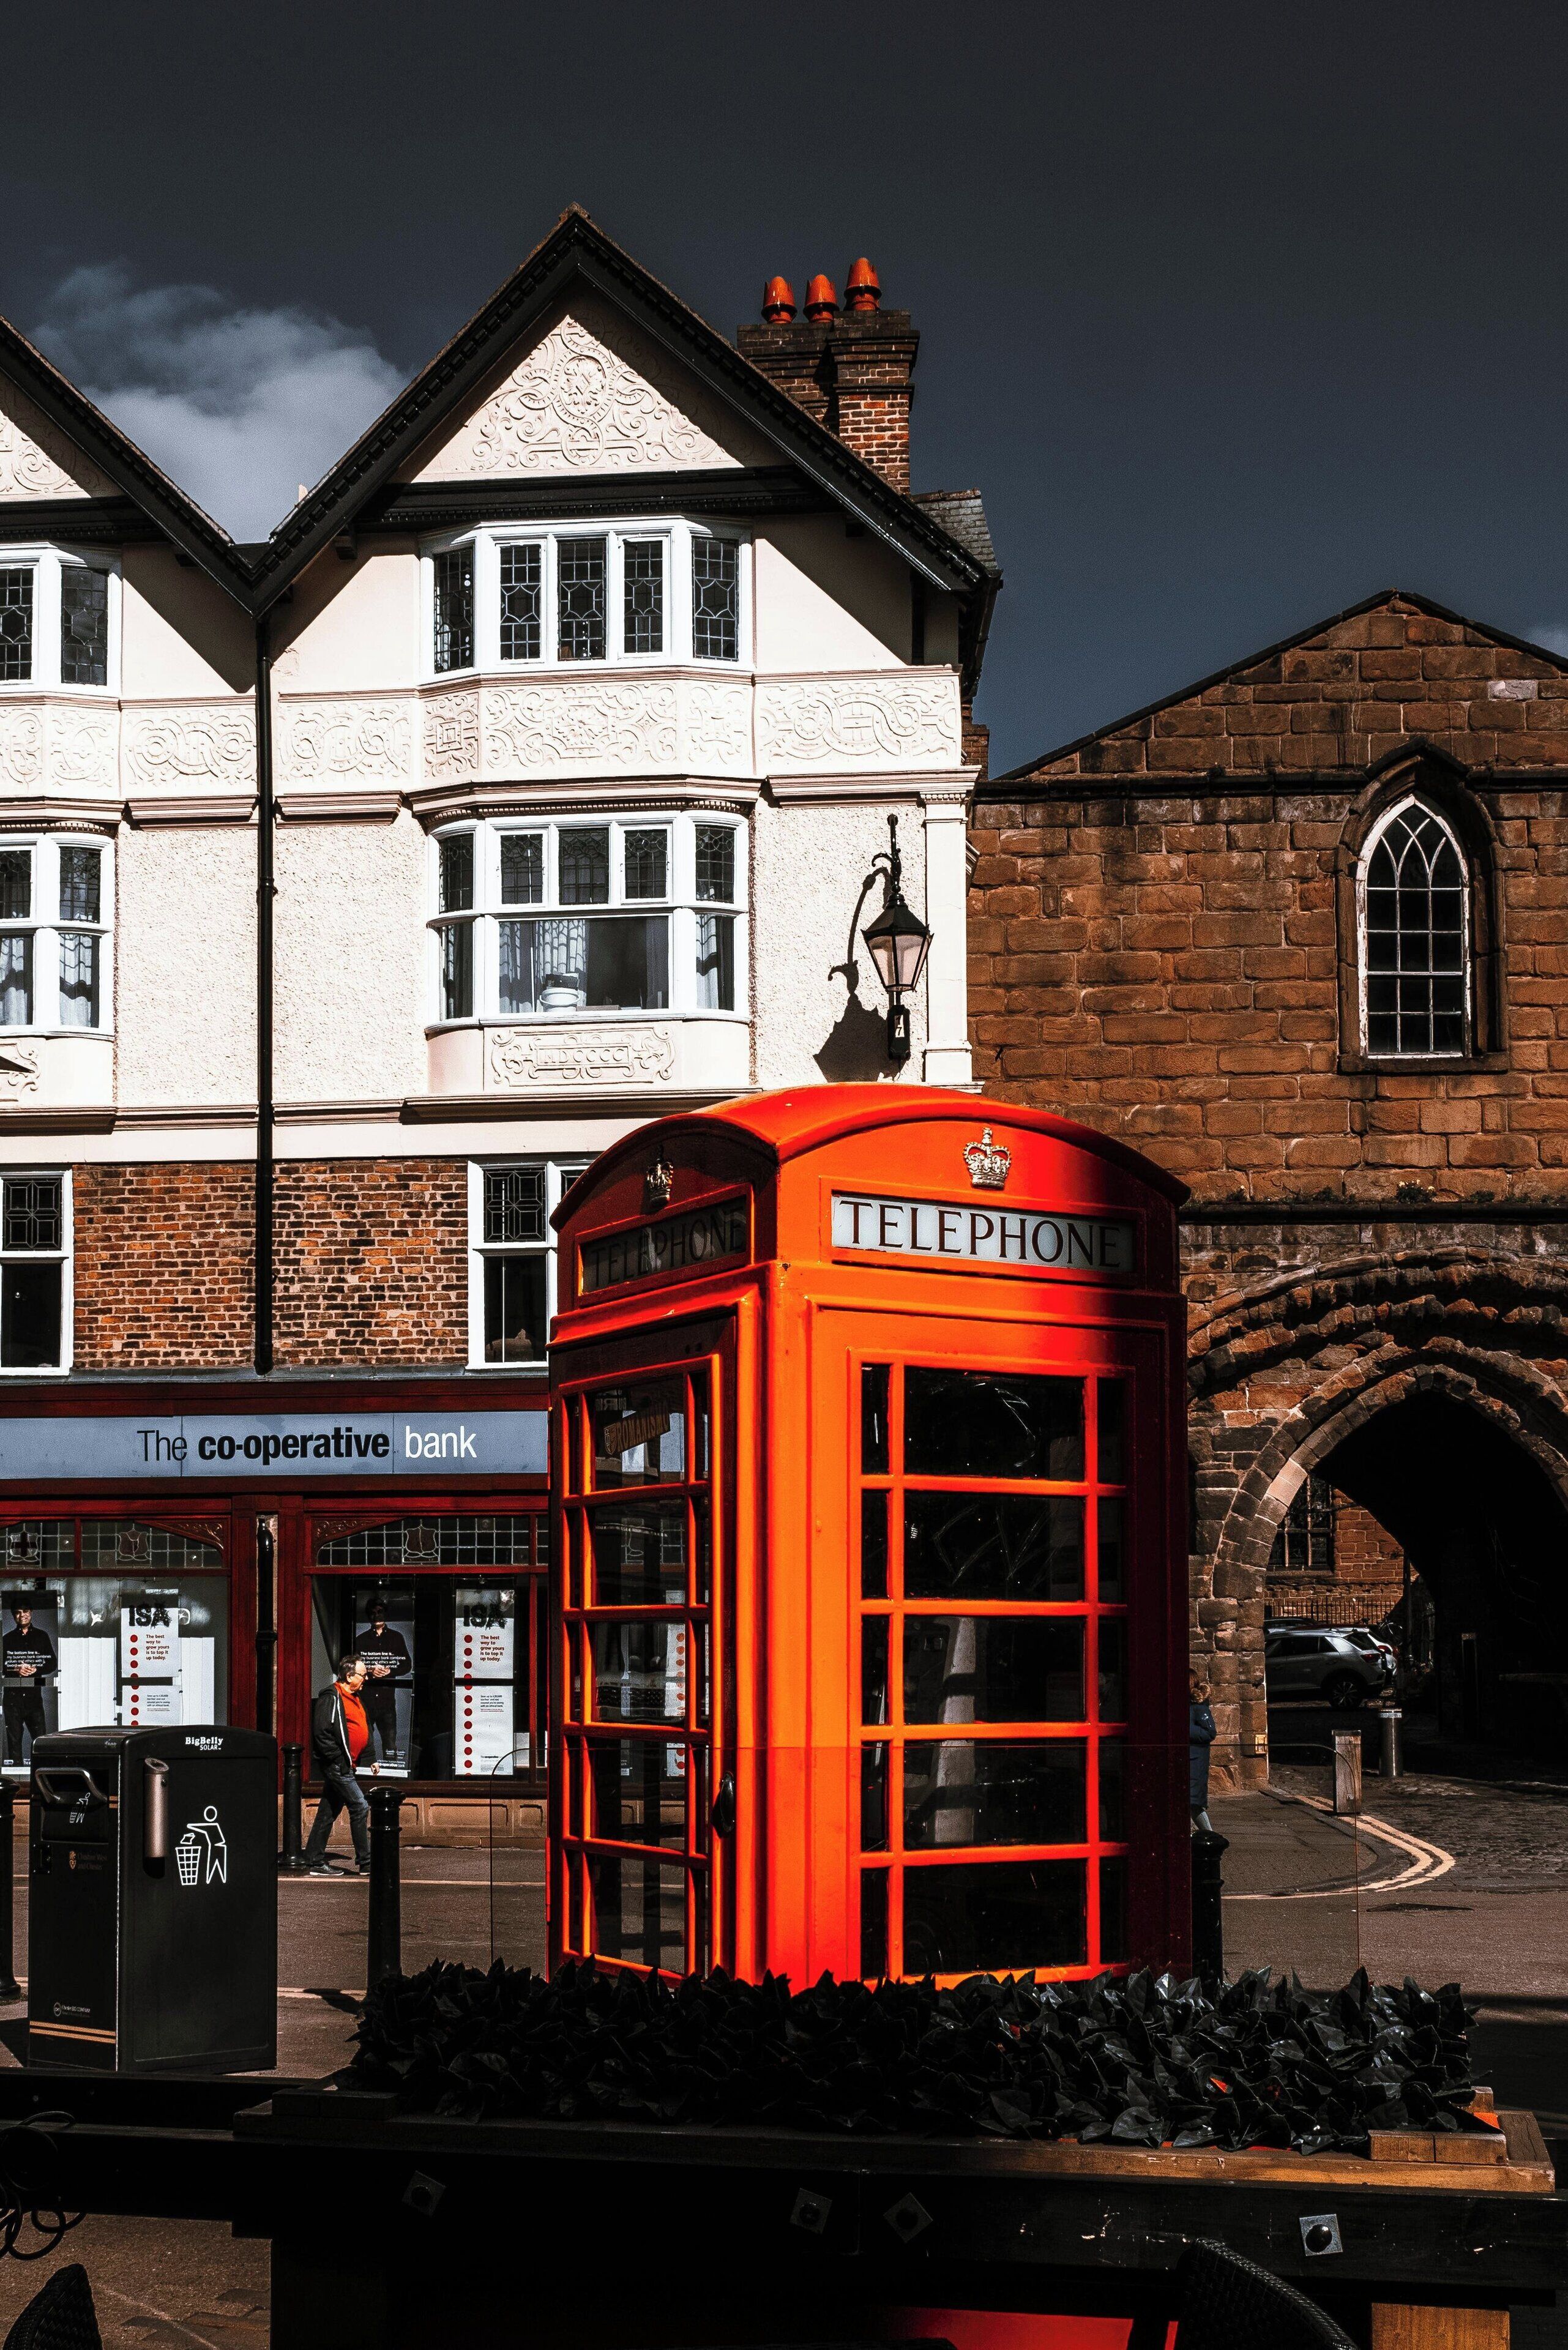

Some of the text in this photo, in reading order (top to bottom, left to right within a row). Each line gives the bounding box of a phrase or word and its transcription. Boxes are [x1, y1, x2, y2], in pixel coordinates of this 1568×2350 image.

[591, 1205, 745, 1287] TELEPHONE
[838, 1199, 1121, 1268] TELEPHONE
[137, 1426, 477, 1465] The co-operative bank
[129, 1603, 171, 1628] ISA
[463, 1603, 507, 1629] ISA
[185, 1736, 223, 1746] BigBelly
